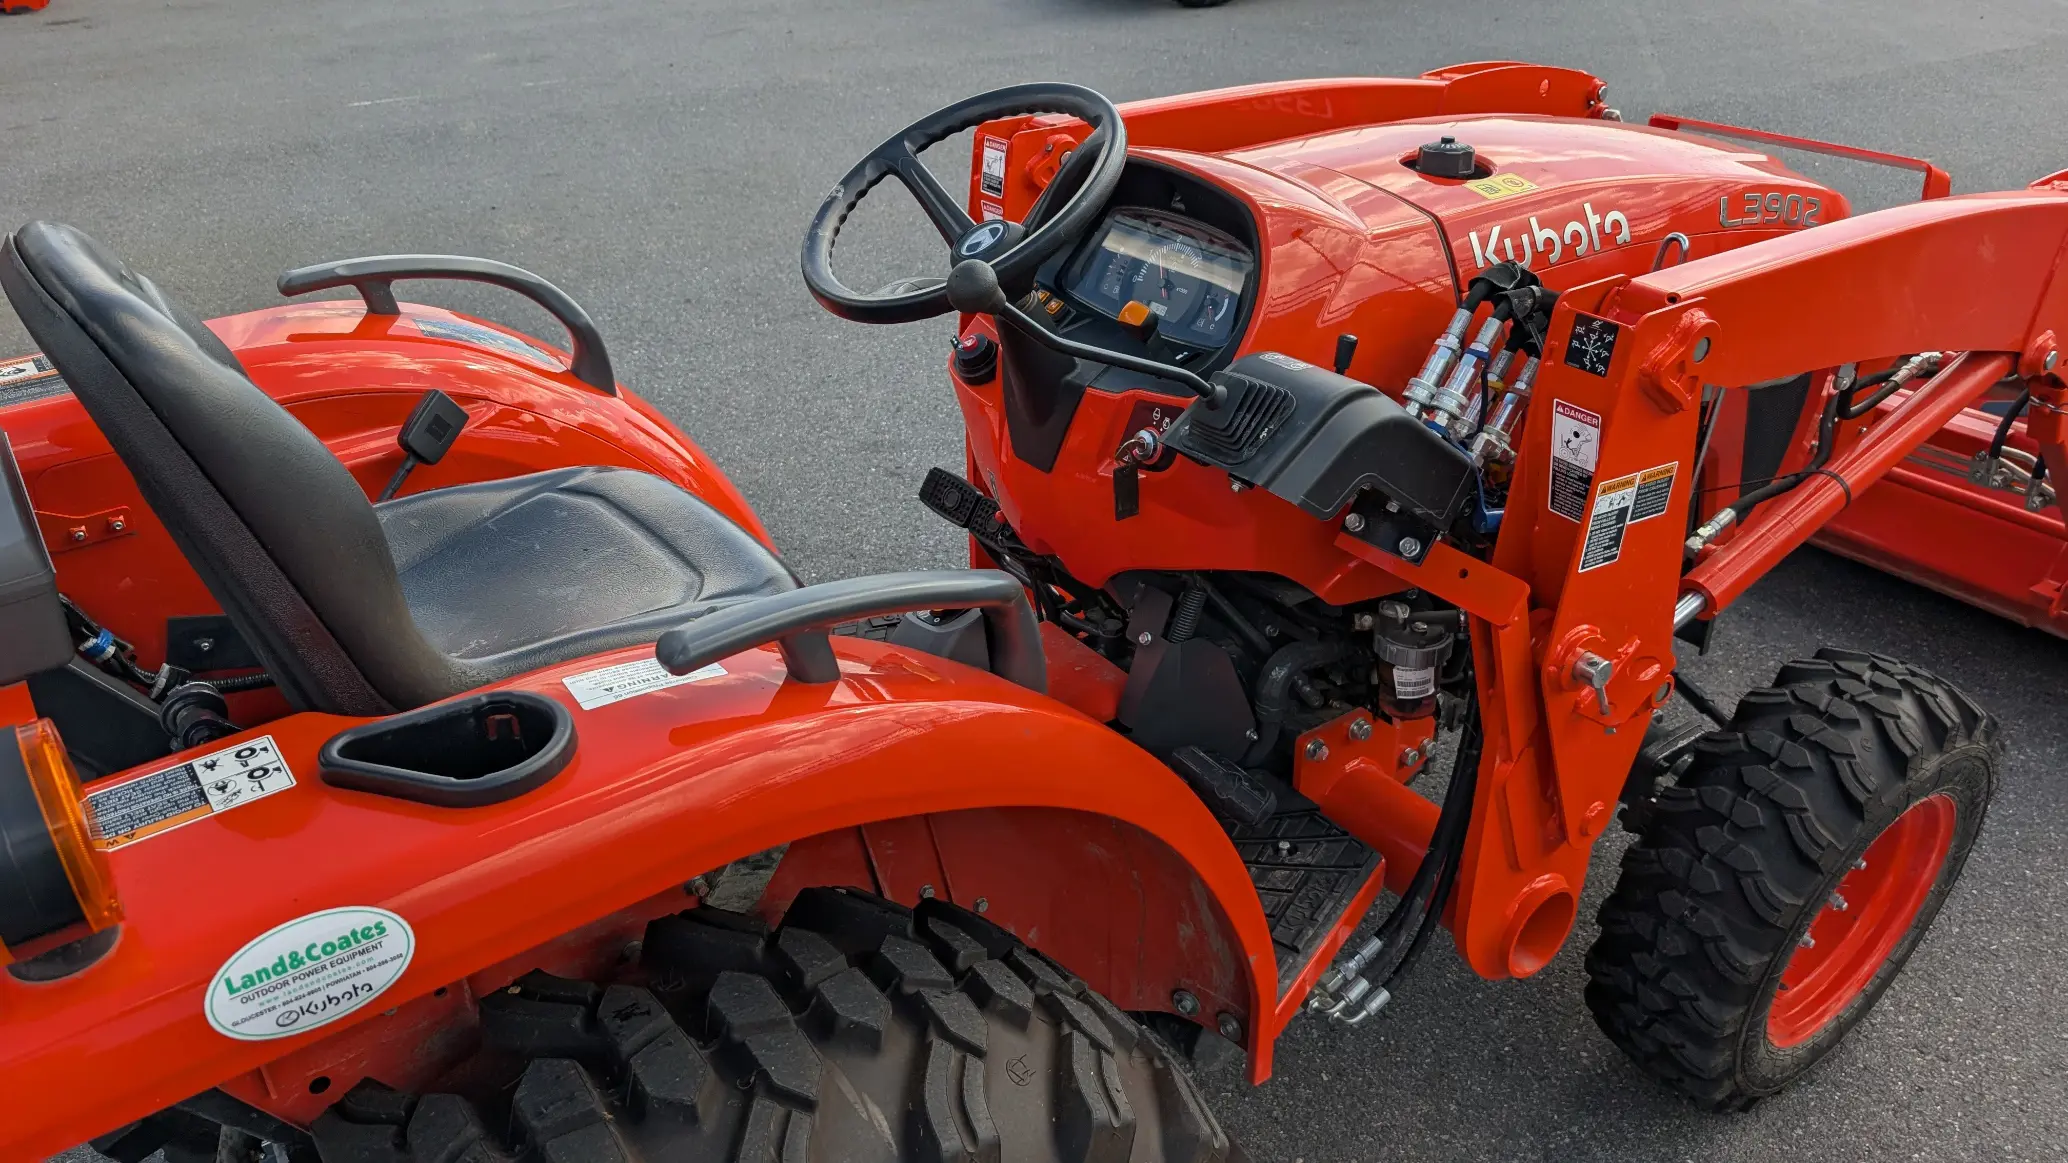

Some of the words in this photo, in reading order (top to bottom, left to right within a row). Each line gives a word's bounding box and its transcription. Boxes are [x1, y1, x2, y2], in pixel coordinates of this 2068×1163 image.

[1719, 192, 1821, 228] L3902
[1469, 202, 1631, 269] Kubota
[1564, 407, 1598, 426] DANGER
[1606, 477, 1635, 492] WARNING
[1646, 466, 1674, 480] WARNING
[617, 673, 669, 689] ARNING
[624, 681, 663, 696] Proposition
[224, 920, 387, 995] Land&Coates
[240, 980, 290, 1004] OUTDOOR
[292, 963, 328, 984] POWER
[329, 940, 384, 968] EQUIPMENT
[232, 1005, 277, 1027] GLOUCESTER
[326, 970, 362, 989] POWHATAN
[298, 982, 373, 1016] Kubota
